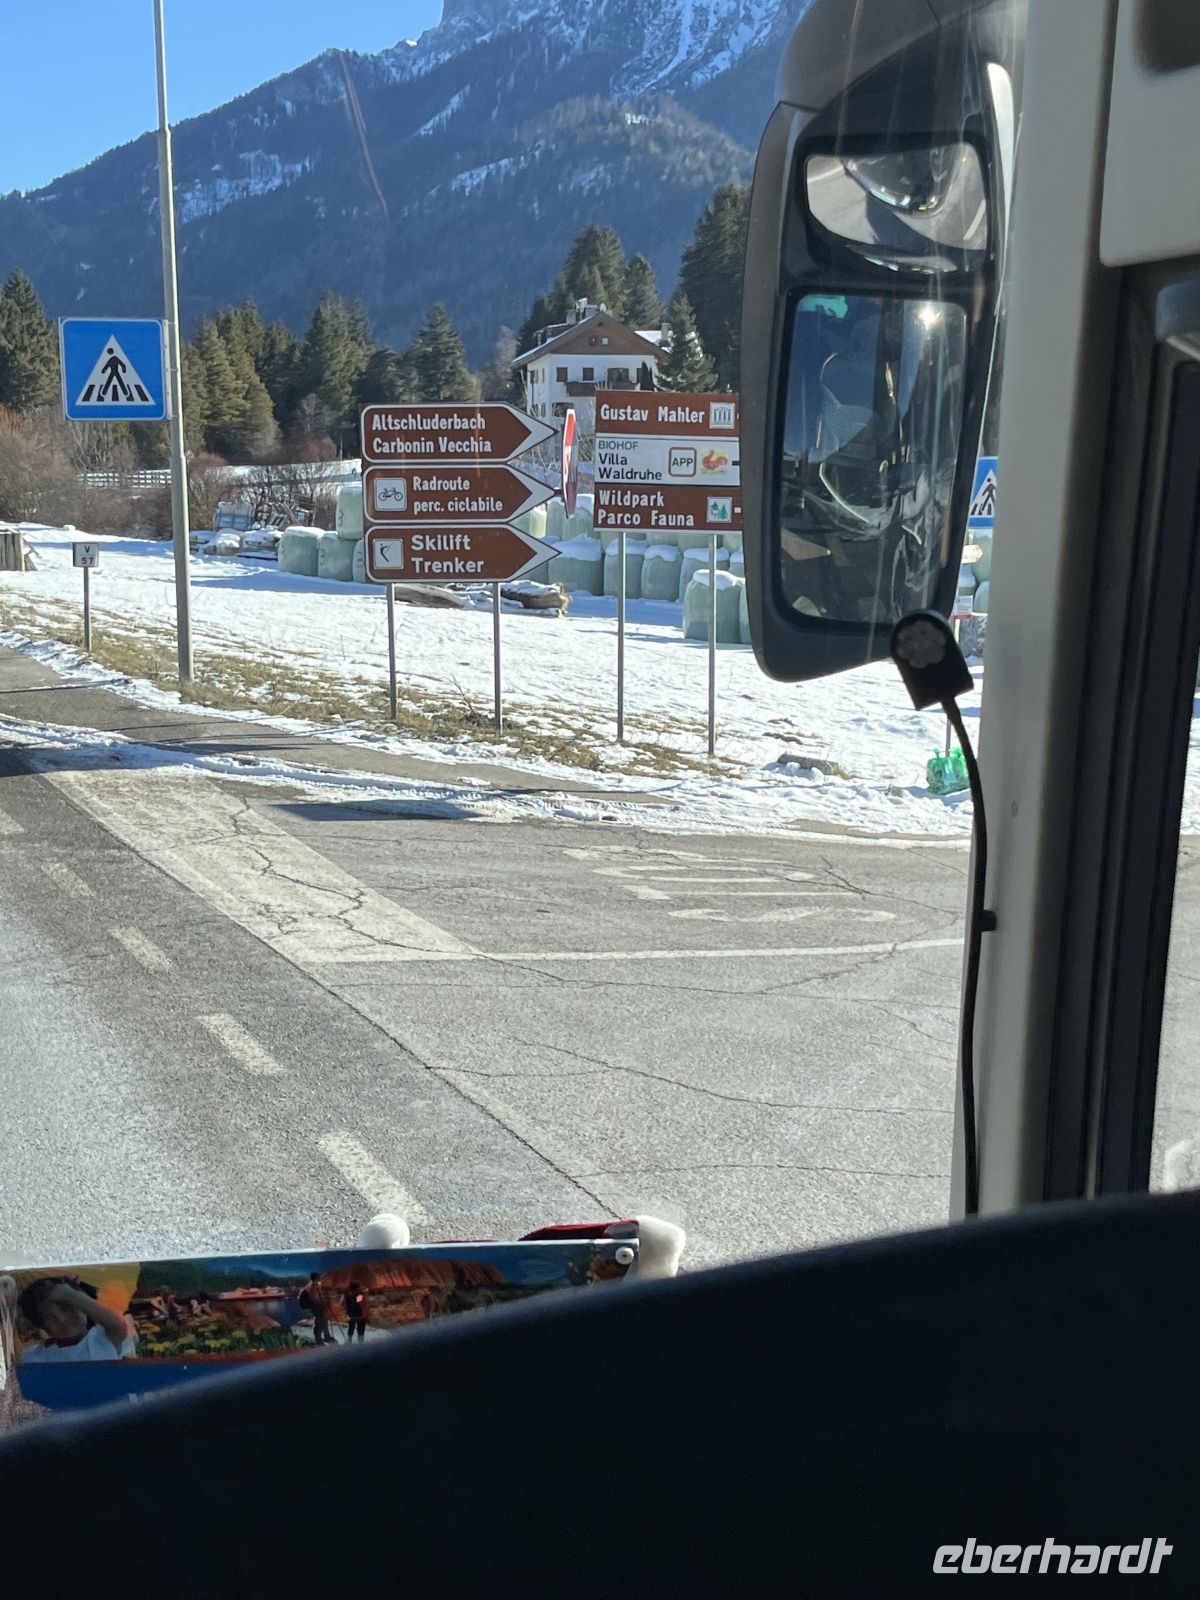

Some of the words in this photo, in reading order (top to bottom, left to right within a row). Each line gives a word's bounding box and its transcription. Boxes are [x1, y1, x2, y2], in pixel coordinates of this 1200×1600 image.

[372, 413, 486, 431] Altschluderbach
[600, 404, 649, 422] Gustav
[658, 407, 705, 423] Mahler
[373, 436, 435, 454] Carbonin
[438, 436, 492, 453] Vecchia
[598, 440, 639, 451] BIOHOF
[598, 452, 628, 466] Villa
[672, 457, 694, 467] APP
[598, 467, 663, 481] Waldruhe
[412, 476, 470, 491] Radroute
[413, 499, 445, 515] perc.
[448, 496, 503, 512] ciclabile
[599, 489, 665, 508] Wildpark
[597, 509, 641, 525] Parco
[651, 510, 695, 527] Fauna
[411, 533, 471, 552] Skilift
[411, 556, 484, 574] Trenker
